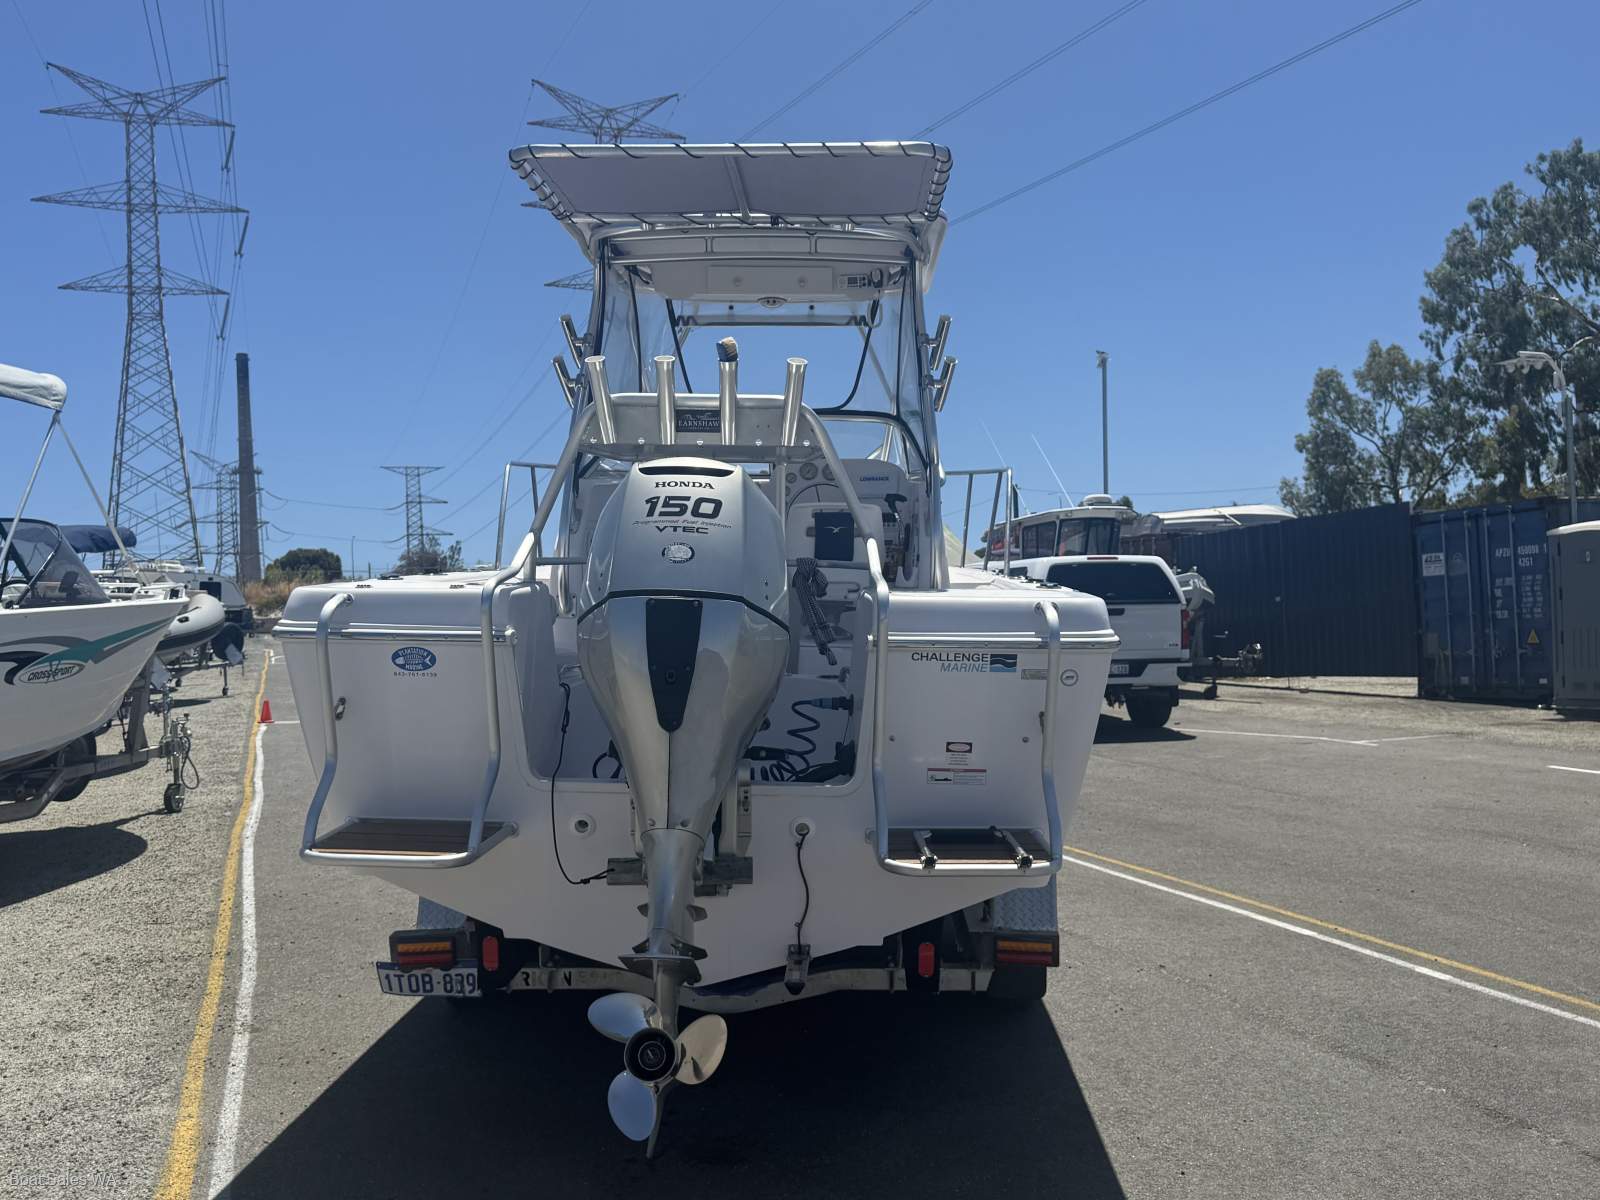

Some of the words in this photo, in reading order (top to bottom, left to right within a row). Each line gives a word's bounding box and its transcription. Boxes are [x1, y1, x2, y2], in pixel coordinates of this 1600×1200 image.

[654, 481, 715, 490] HONDA
[644, 495, 724, 520] 150
[655, 525, 710, 535] VTEC
[911, 652, 989, 662] CHALLENGE
[940, 662, 988, 673] MARINE
